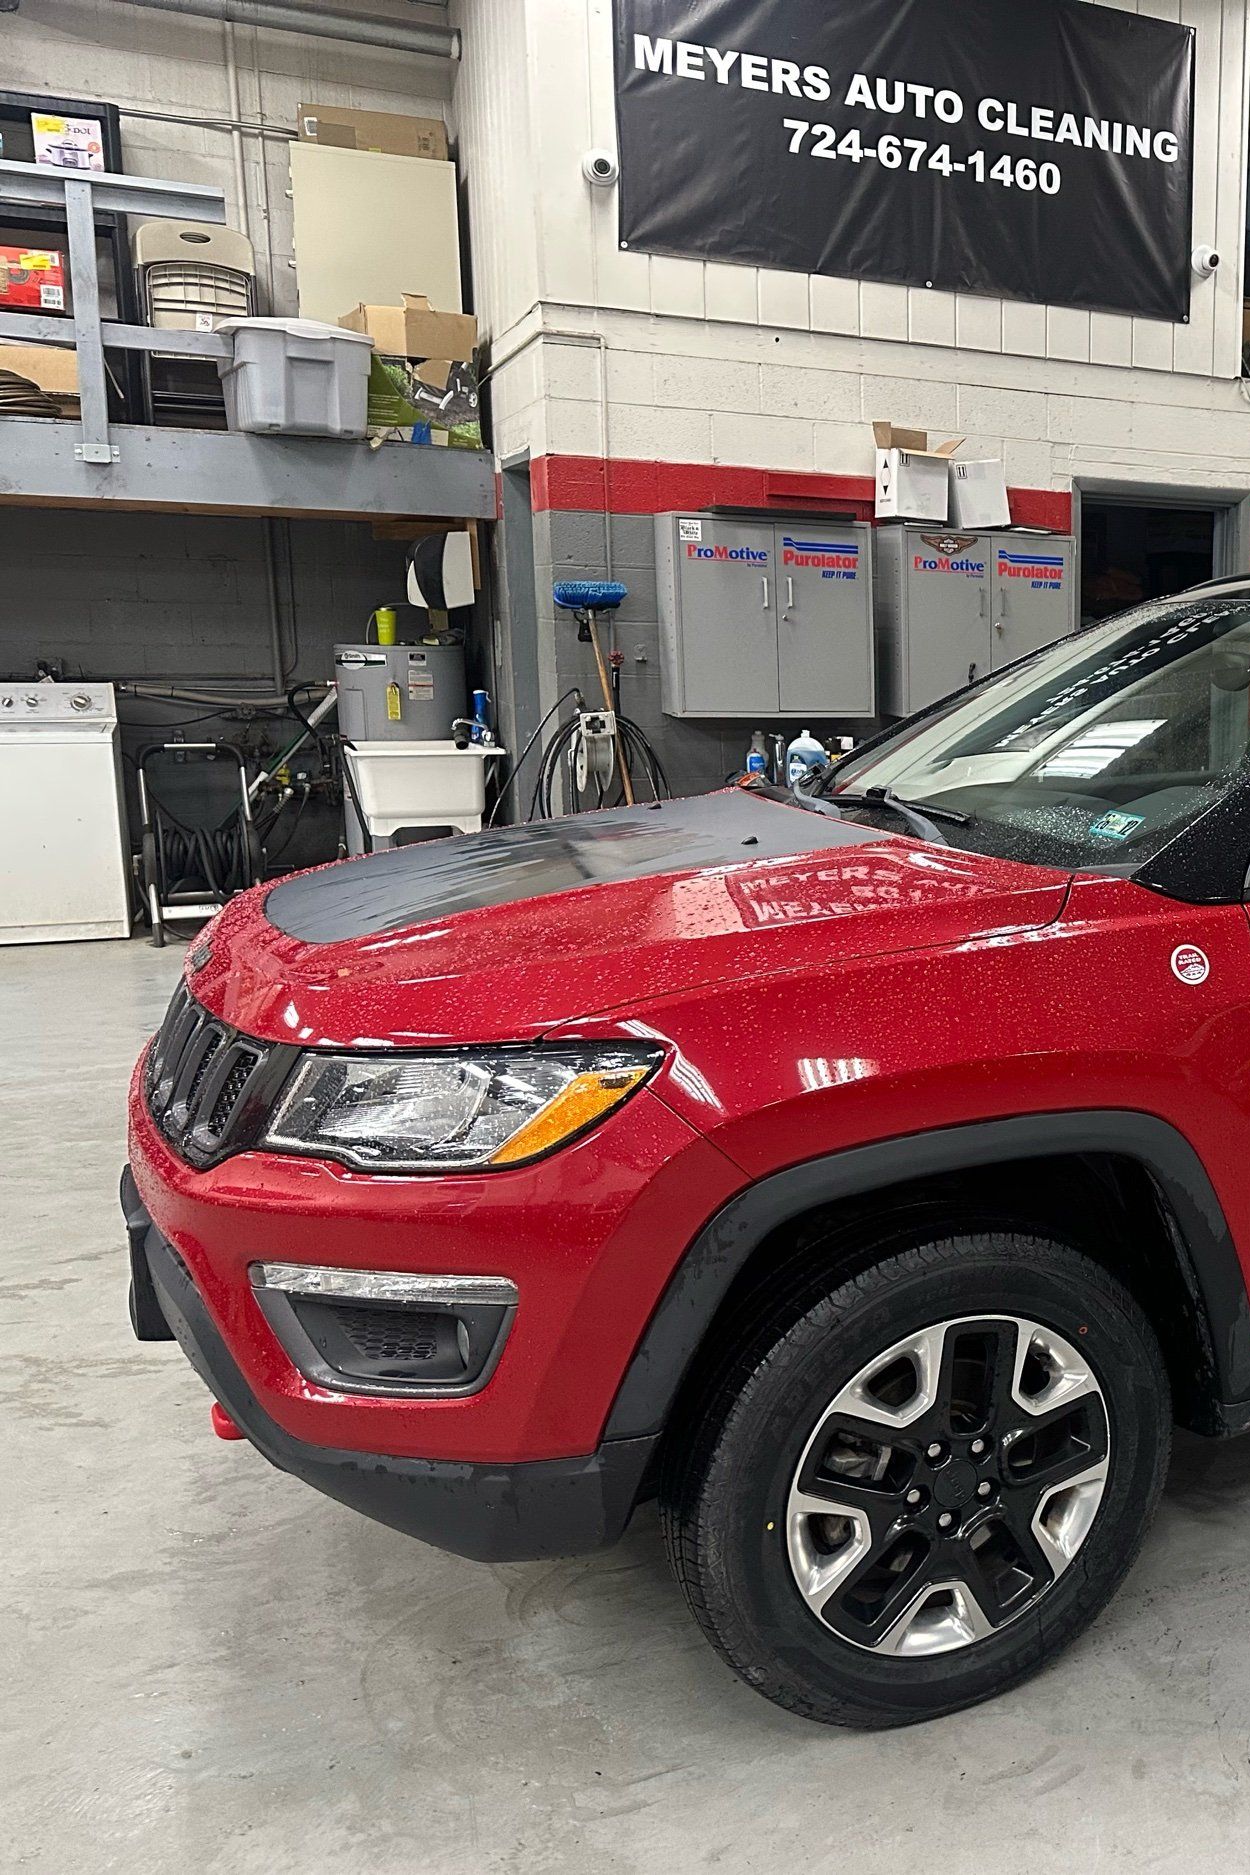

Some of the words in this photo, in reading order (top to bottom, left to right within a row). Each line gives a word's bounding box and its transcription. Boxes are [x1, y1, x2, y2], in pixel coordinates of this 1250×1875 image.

[633, 33, 831, 101] MEYERS
[845, 73, 964, 124] AUTO
[977, 98, 1179, 163] CLEANING
[783, 119, 1062, 195] 724-674-1460
[687, 544, 768, 561] ProMotive
[783, 550, 859, 569] Purolator
[914, 555, 984, 572] ProMotive
[998, 562, 1064, 579] Purolator
[822, 570, 835, 579] KEEP
